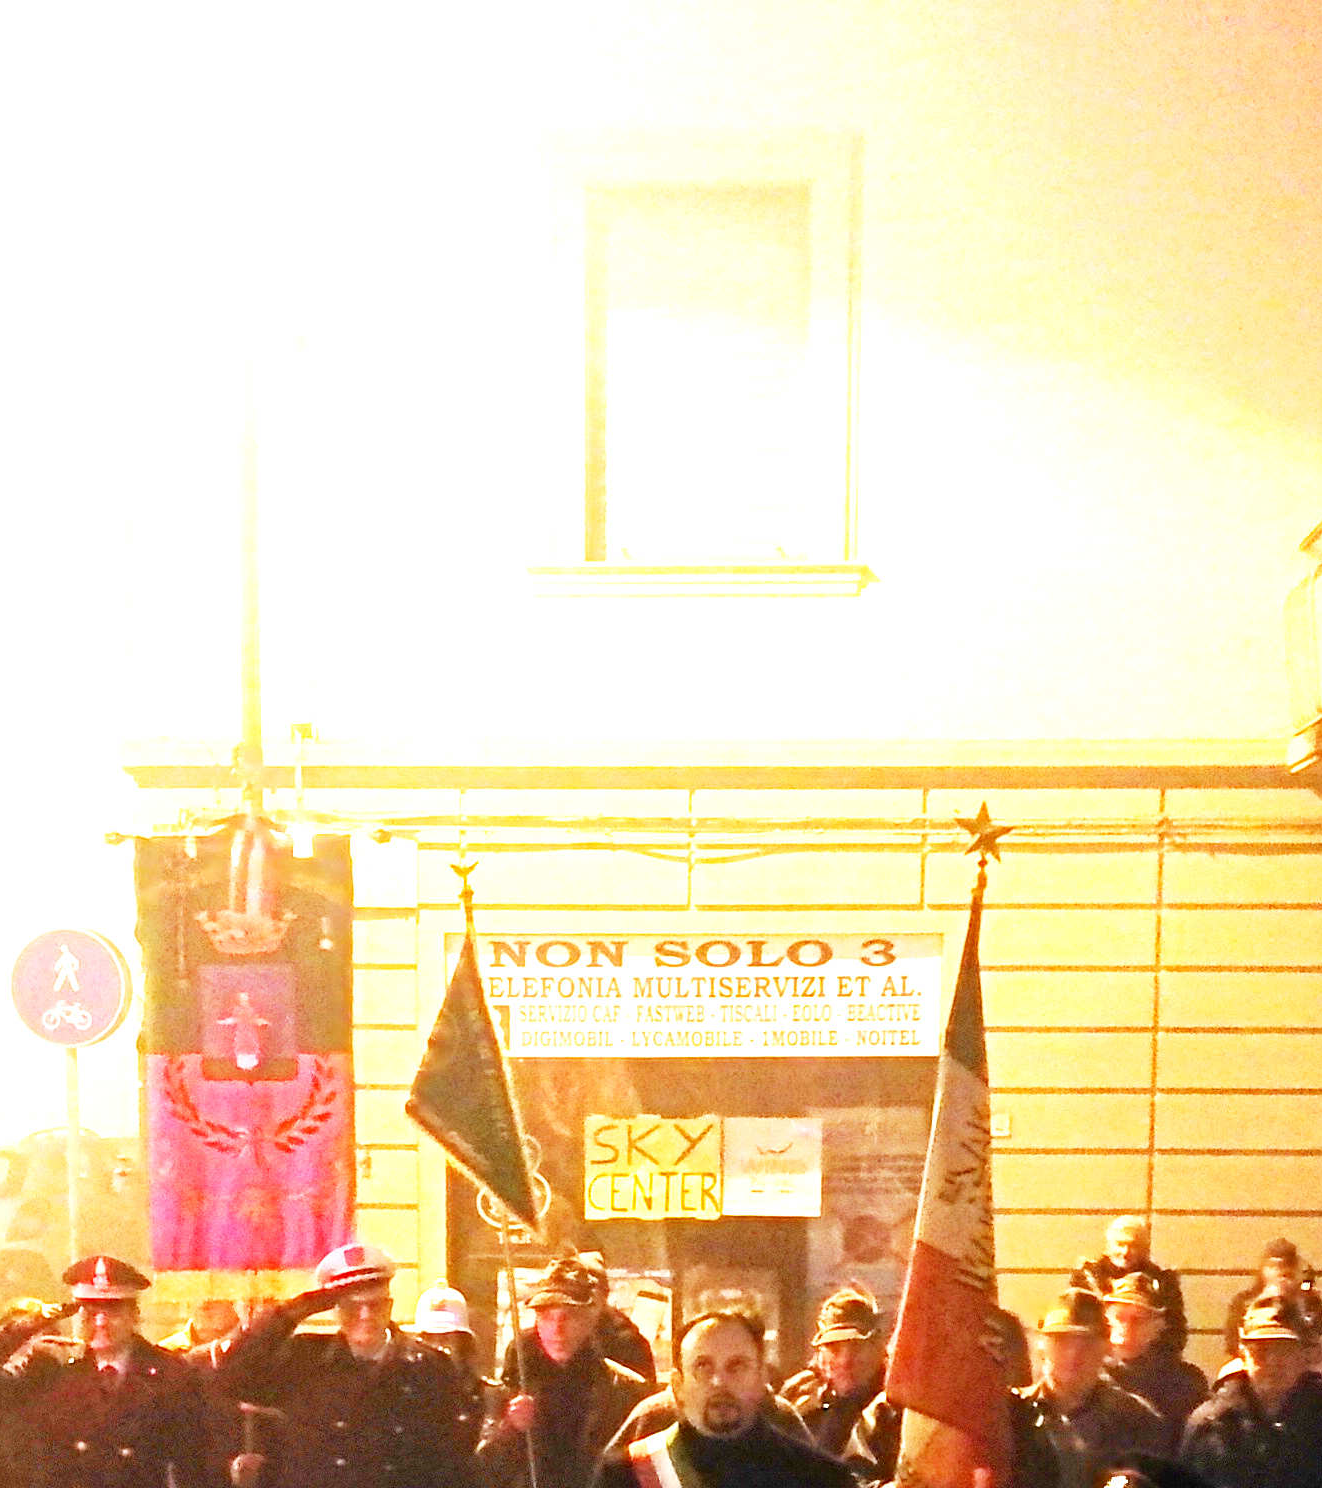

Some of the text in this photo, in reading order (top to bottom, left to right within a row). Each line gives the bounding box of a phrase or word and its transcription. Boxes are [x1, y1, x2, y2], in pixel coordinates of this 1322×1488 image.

[489, 939, 896, 967] NON SOLO 3
[488, 976, 922, 998] ELEFONIA MULTISERVIZI ET AL.
[519, 1005, 588, 1023] SERVIZIO
[592, 1005, 622, 1023] CAF
[637, 1004, 706, 1023] FASTWEB
[720, 1004, 777, 1023] TISCALI
[792, 1004, 832, 1022] EOLO
[521, 1031, 613, 1047] DIGIMOBIL
[632, 1030, 743, 1048] LYCAMOBILE
[763, 1030, 839, 1047] 1MOBILE
[856, 1029, 921, 1046] NOITEL
[590, 1123, 713, 1166] SKY
[588, 1172, 721, 1212] CENTER
